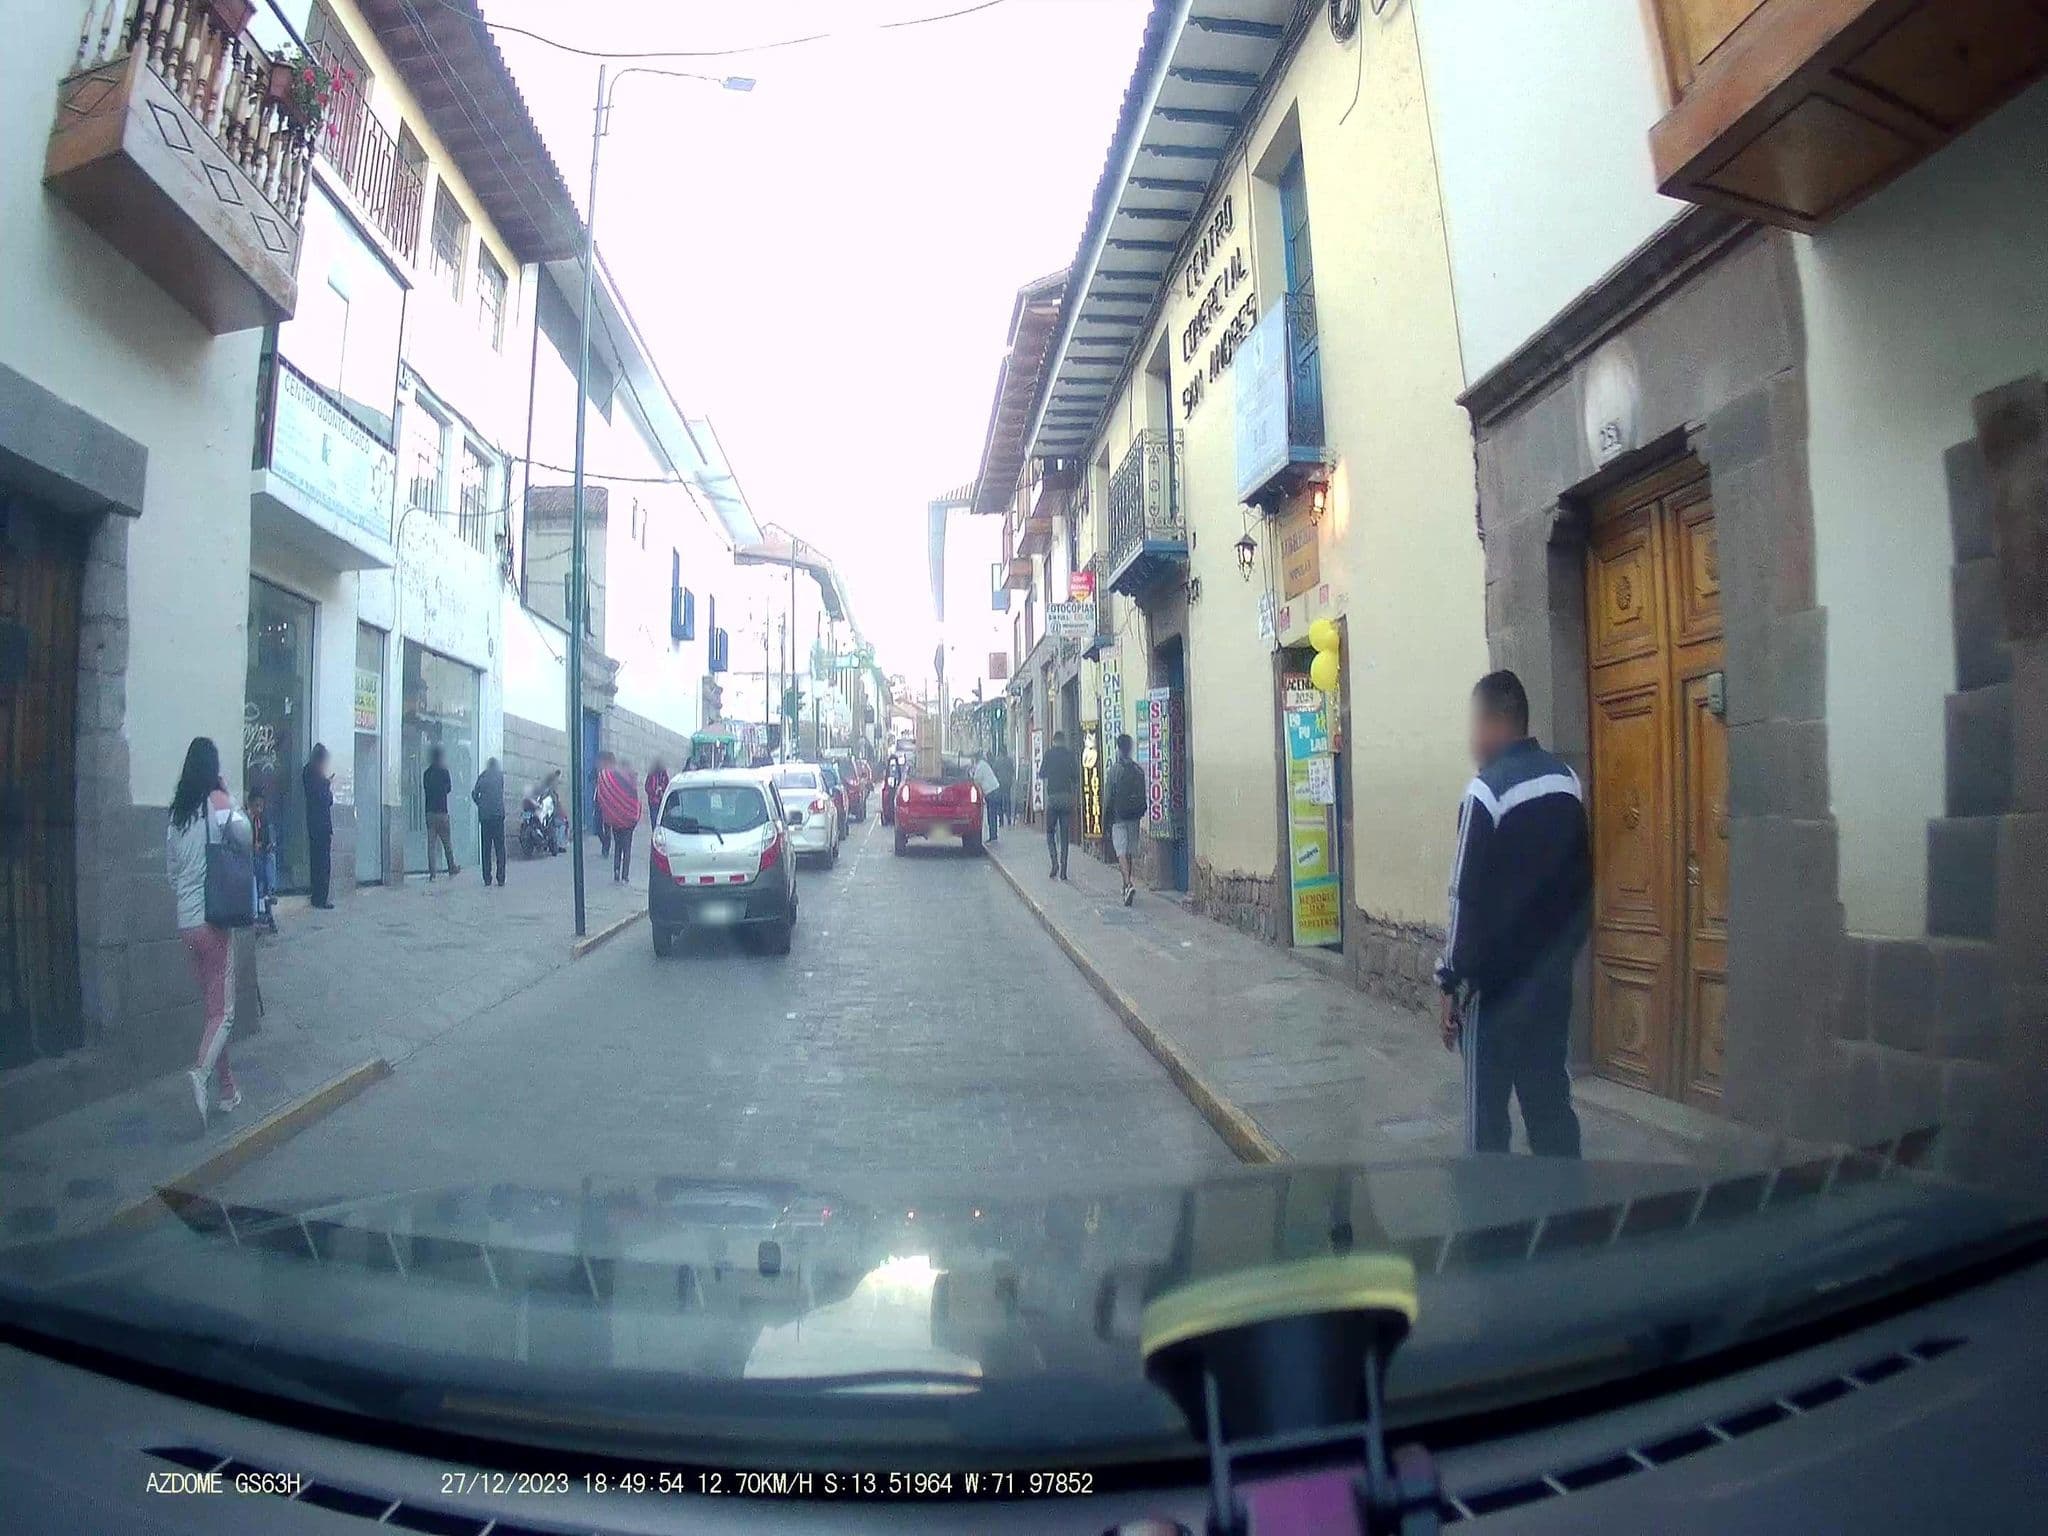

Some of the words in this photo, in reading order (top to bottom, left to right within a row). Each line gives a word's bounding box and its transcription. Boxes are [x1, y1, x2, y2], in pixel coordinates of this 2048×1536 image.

[1186, 194, 1235, 298] CENTRO
[1182, 247, 1249, 364] COMERCIAL
[1182, 369, 1205, 421] SAN
[1209, 292, 1258, 384] ANDRES
[284, 373, 316, 413] CENTRO
[317, 400, 371, 455] ODONTOLOGICO
[1150, 700, 1163, 822] SELLOS
